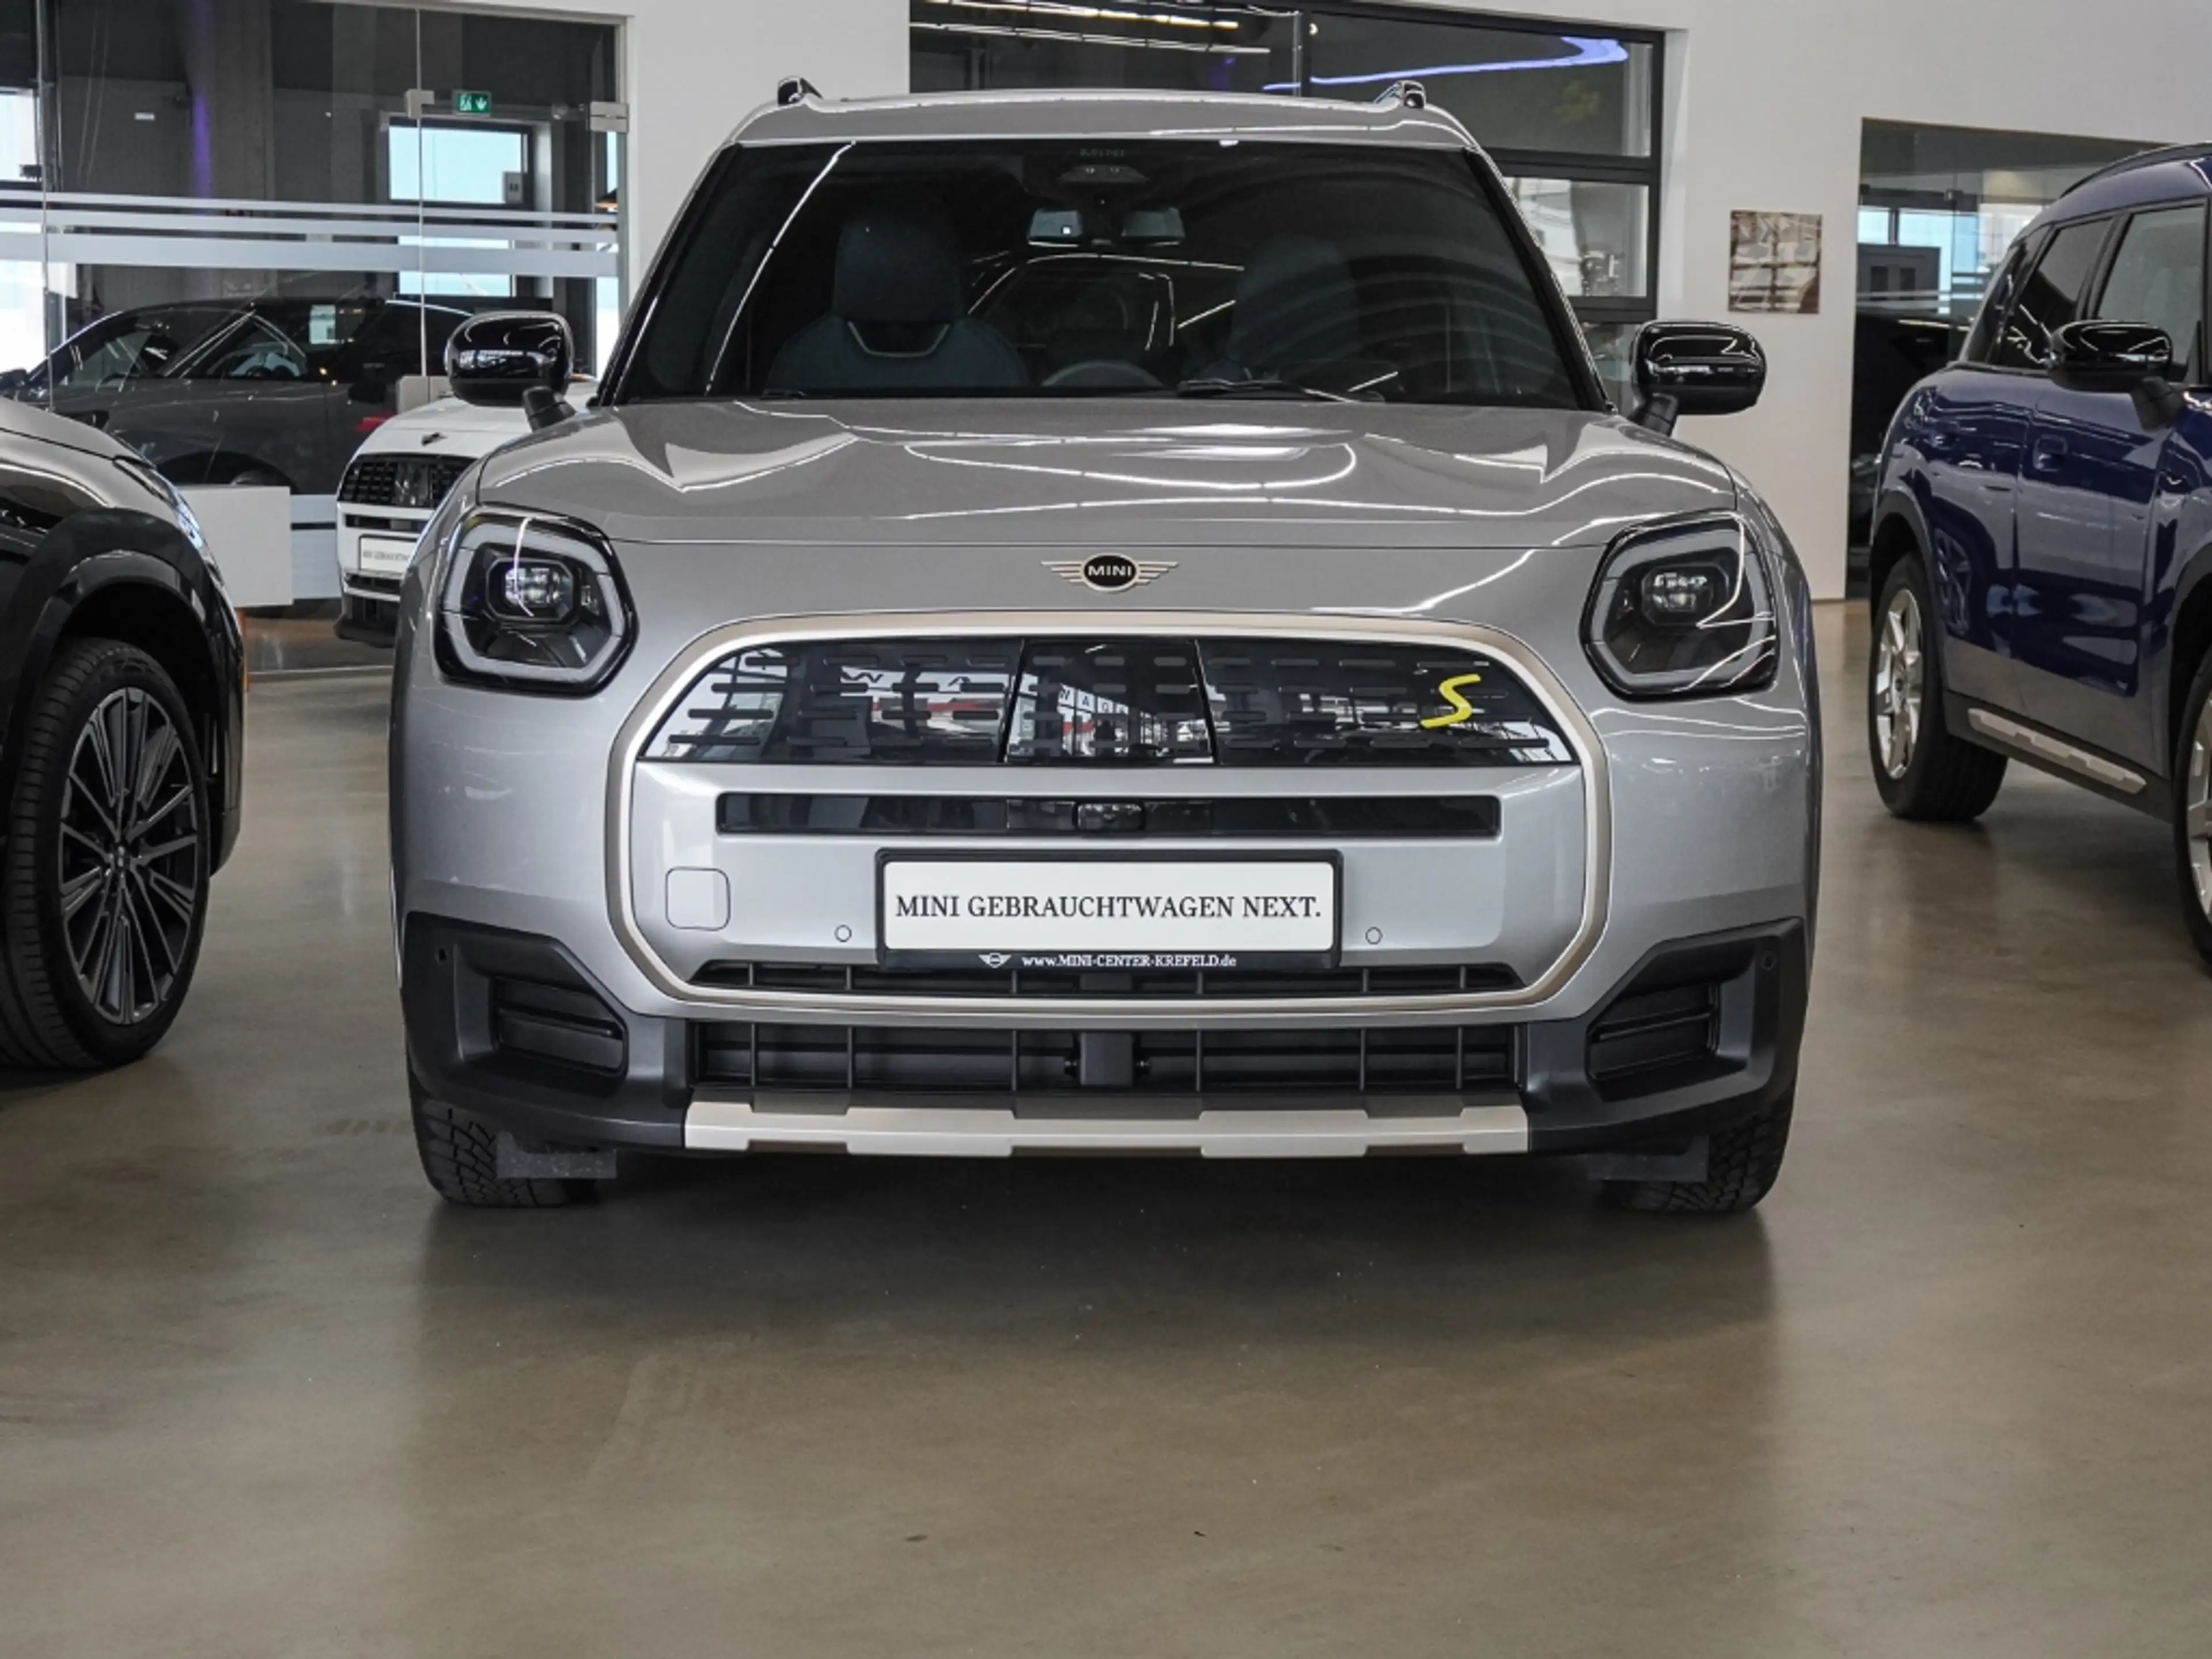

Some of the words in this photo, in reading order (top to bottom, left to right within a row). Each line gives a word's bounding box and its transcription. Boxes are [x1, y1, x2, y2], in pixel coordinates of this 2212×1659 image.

[1088, 565, 1132, 576] MINI
[1420, 673, 1481, 729] S
[896, 896, 959, 917] MINI
[968, 896, 1234, 917] GEBRAUCHTWAGEN
[1243, 896, 1321, 917] NEXT.
[1021, 954, 1237, 967] www.MINI-CENTER-KREFELD.de
